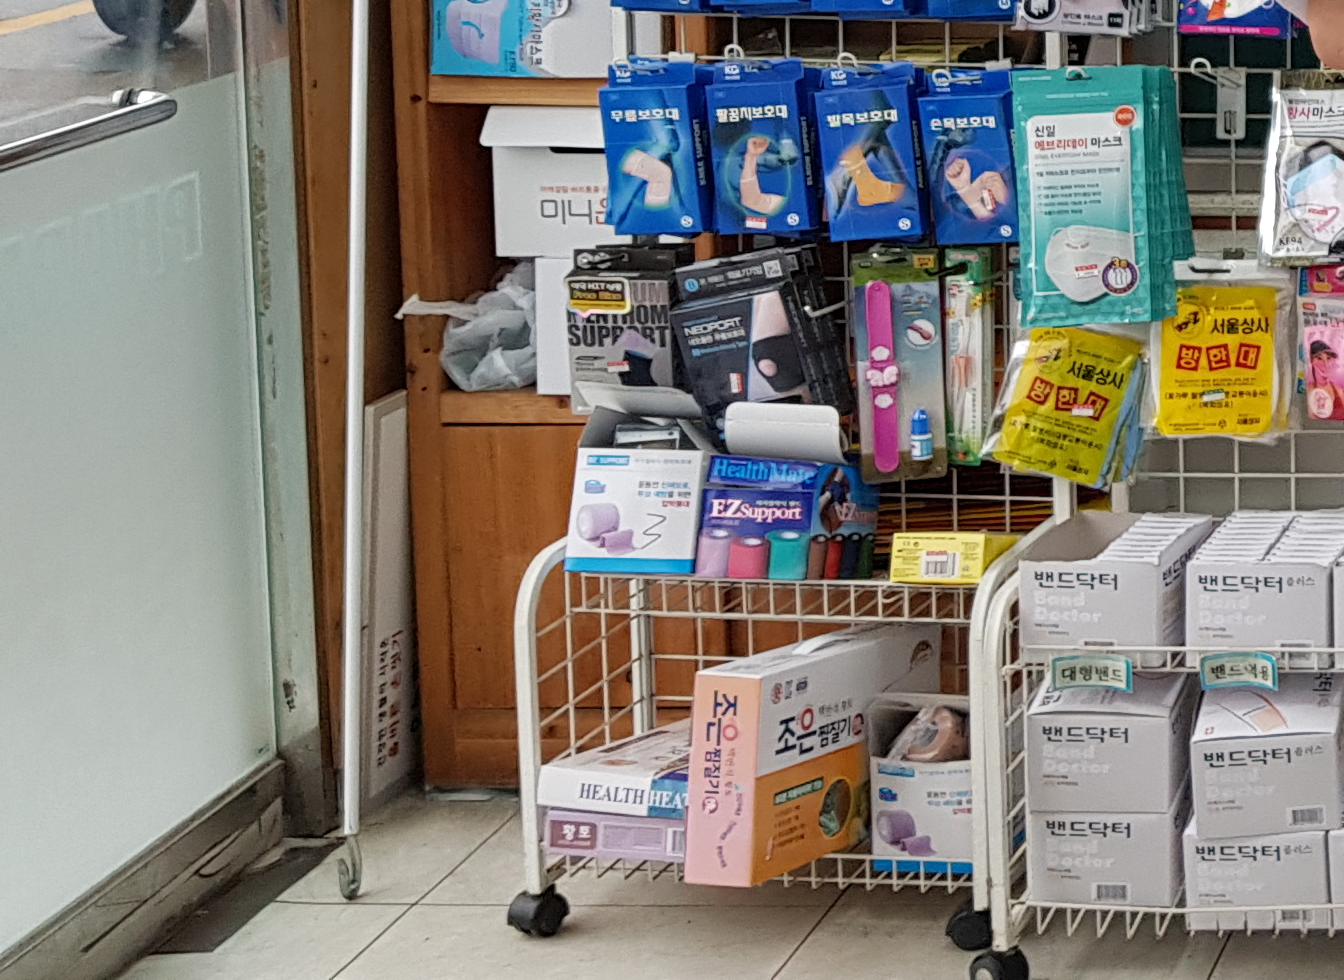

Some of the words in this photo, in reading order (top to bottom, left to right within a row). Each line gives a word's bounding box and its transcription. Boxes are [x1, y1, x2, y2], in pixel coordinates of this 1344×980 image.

[610, 107, 680, 123] 무릎보호대
[716, 104, 788, 121] 팔꿈치보호대
[826, 109, 898, 127] 발목보호대
[930, 115, 996, 130] 손목보호대
[1034, 125, 1056, 138] 신일
[1034, 139, 1088, 152] 에브리데이
[1090, 136, 1123, 148] 마스크
[1278, 235, 1303, 248] KF94
[1211, 317, 1270, 335] 서울상사
[568, 326, 669, 348] SUPPORT
[1179, 346, 1258, 369] 방한대
[1066, 360, 1125, 390] 서울상사
[1030, 379, 1107, 417] 방한대
[710, 498, 803, 522] EZSupport
[1034, 570, 1118, 591] 밴드닥터
[1198, 574, 1283, 594] 밴드닥터
[1061, 665, 1125, 683] 대형밴드
[705, 689, 738, 747] 조은
[774, 705, 817, 756] 조은
[817, 715, 852, 748] 찜질기
[1042, 725, 1130, 744] 밴드닥터
[1203, 747, 1292, 768] 밴드닥터
[704, 747, 722, 794] 찜질기
[578, 782, 646, 806] HEALTH
[562, 823, 591, 839] 황토
[1046, 819, 1131, 839] 밴드닥터
[1195, 845, 1282, 863] 밴드닥터
